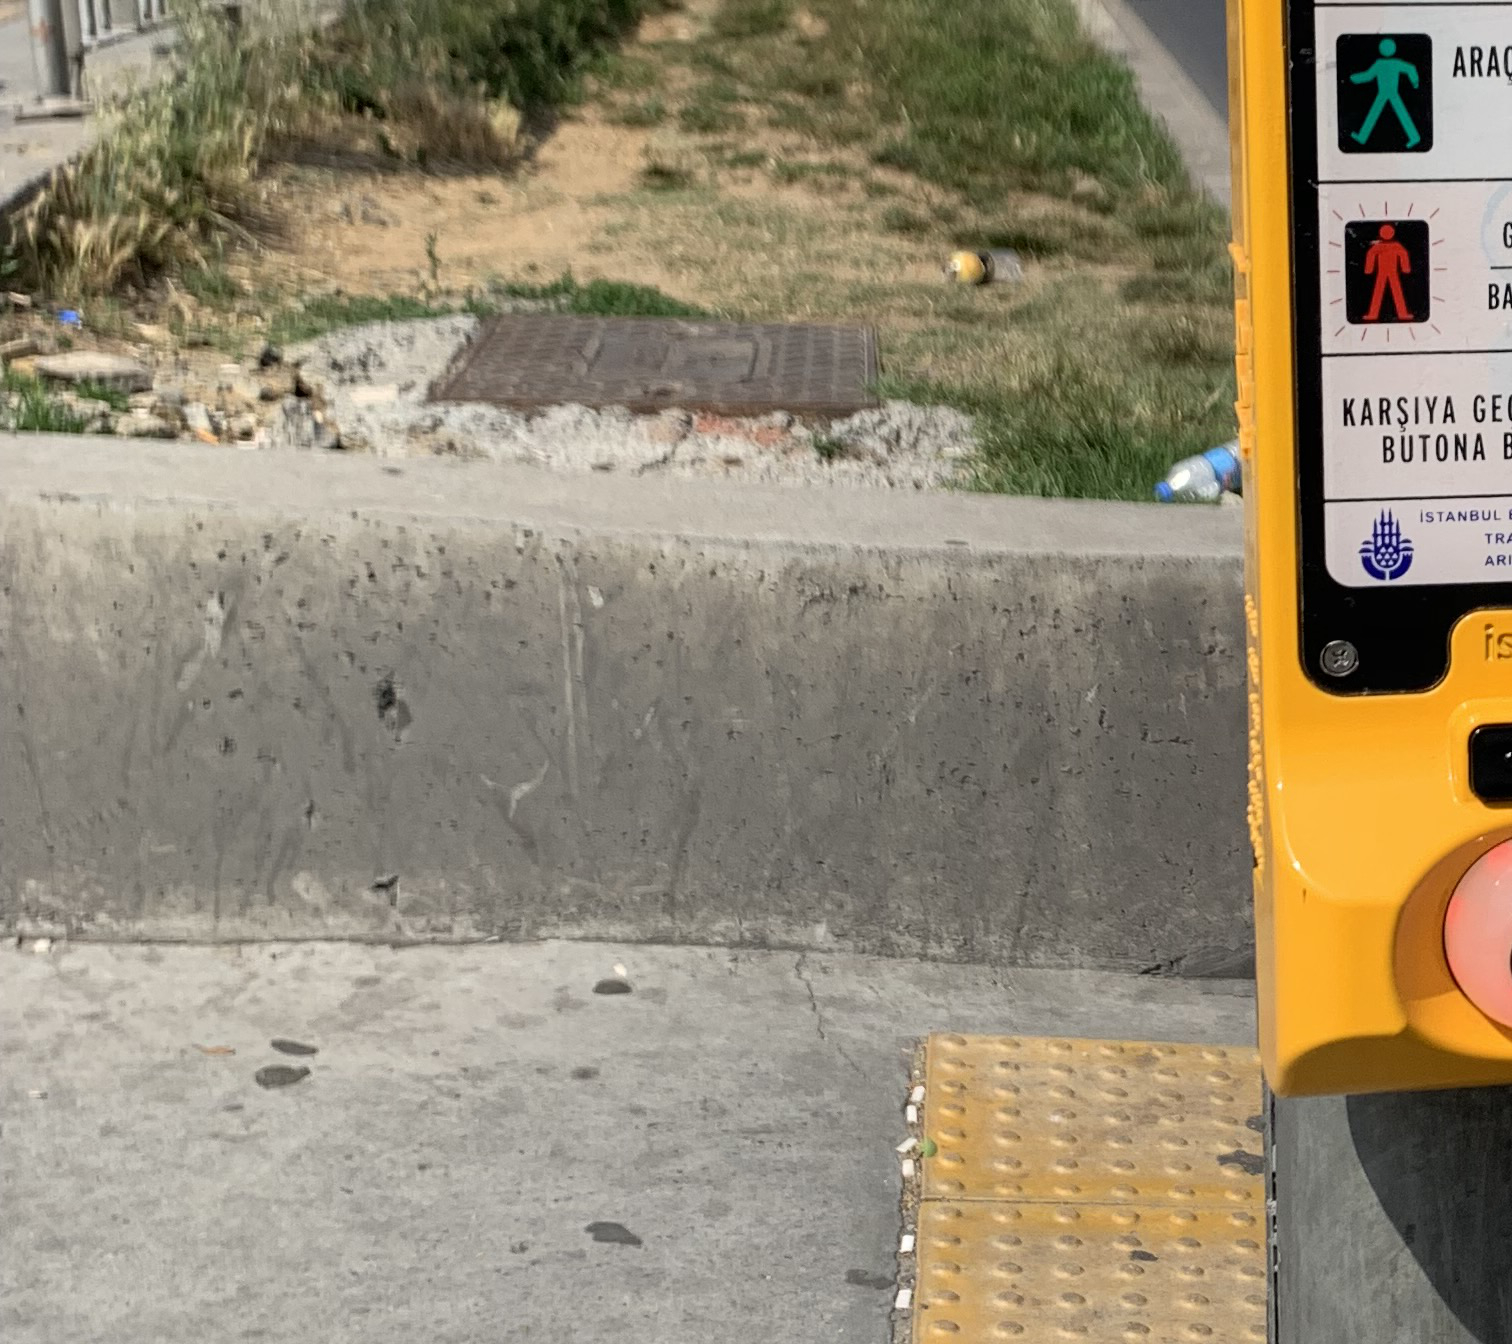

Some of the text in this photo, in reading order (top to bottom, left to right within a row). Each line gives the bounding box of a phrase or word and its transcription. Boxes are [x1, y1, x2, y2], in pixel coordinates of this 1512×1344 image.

[1342, 395, 1456, 429] KARŞIYA
[1382, 432, 1486, 464] BUTONA
[1420, 508, 1502, 523] İSTANBUL
